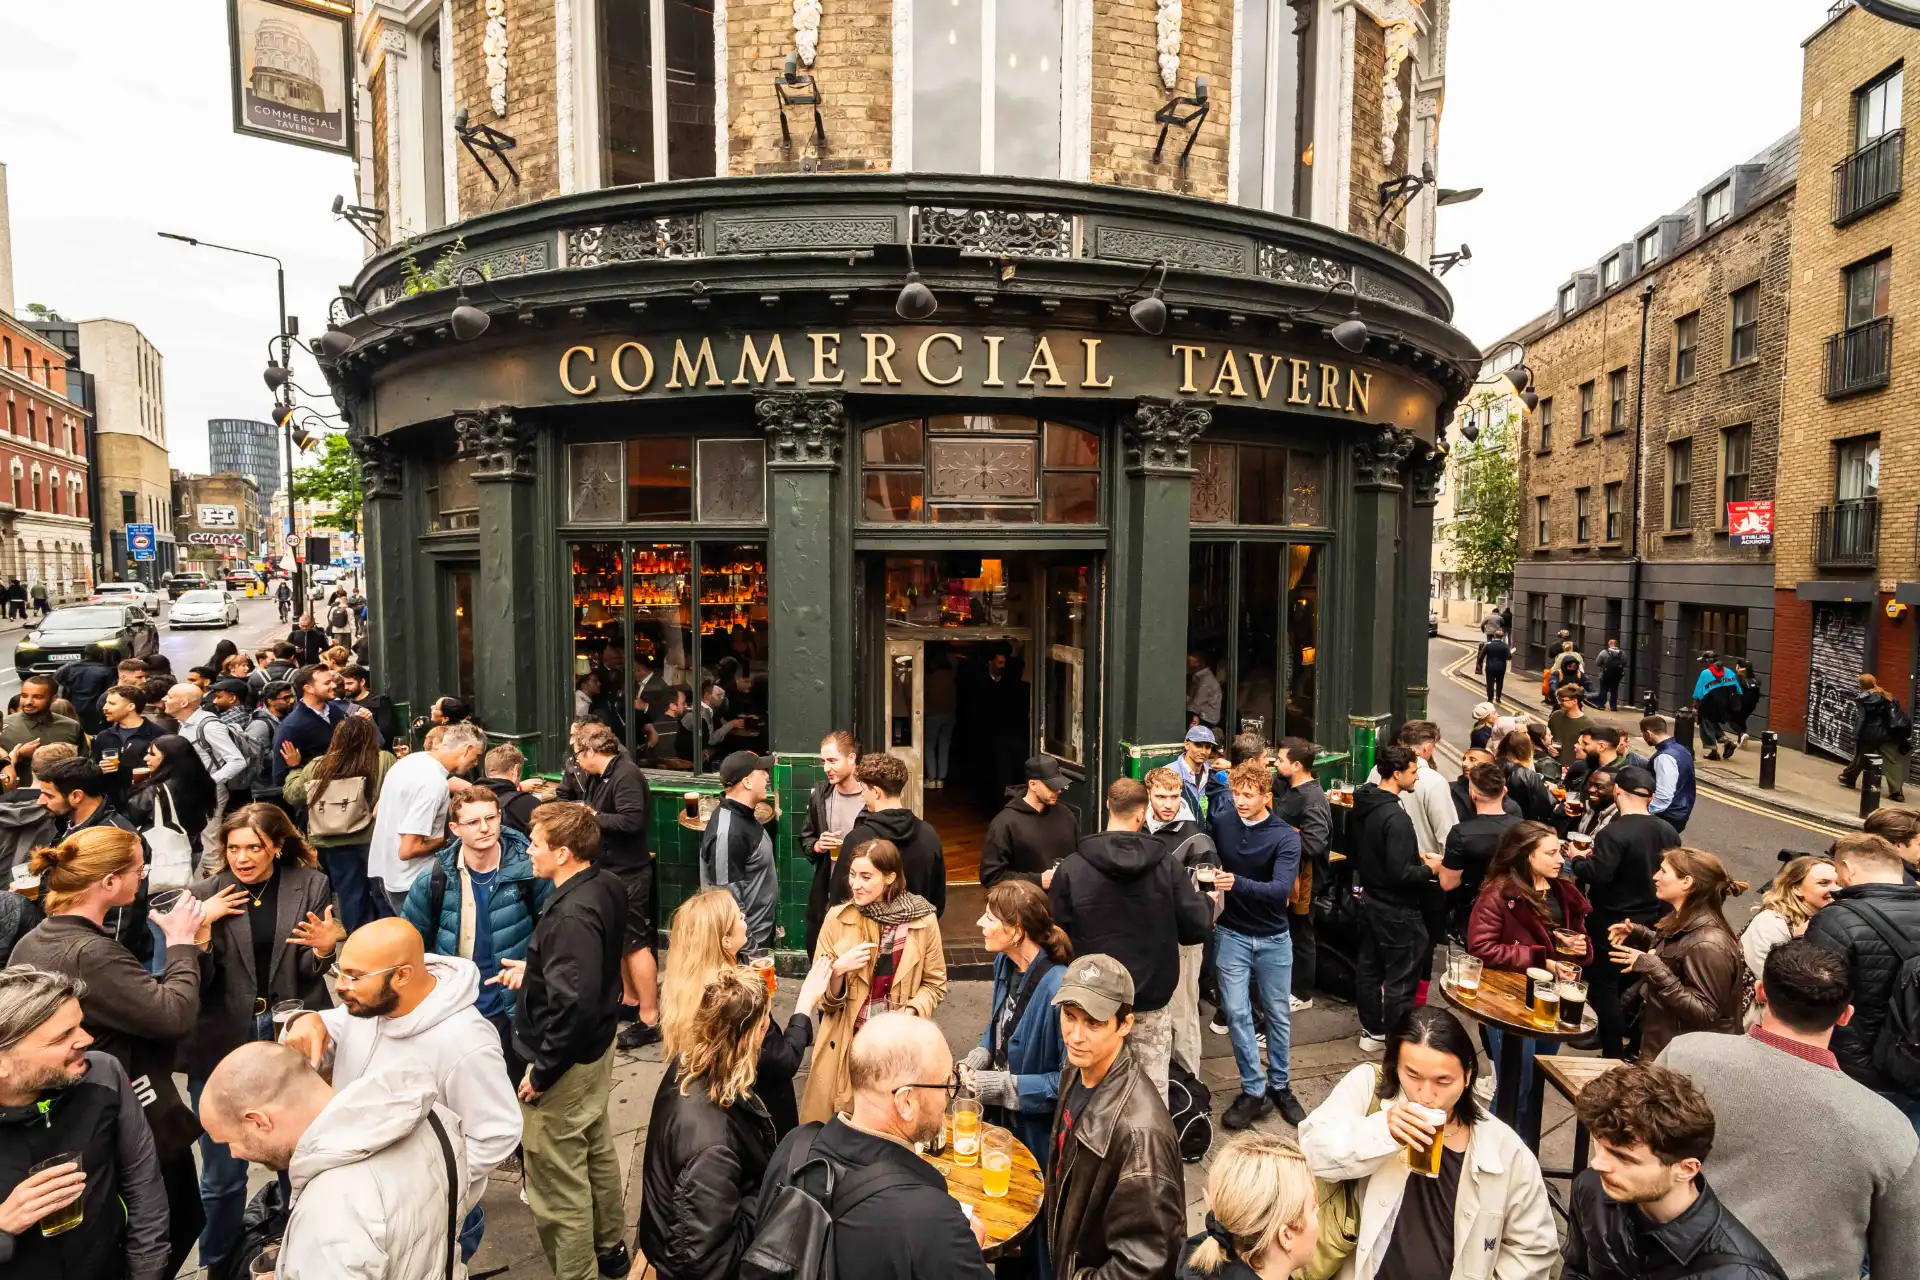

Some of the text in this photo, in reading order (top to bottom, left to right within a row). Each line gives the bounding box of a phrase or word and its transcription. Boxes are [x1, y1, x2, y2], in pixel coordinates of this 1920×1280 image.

[254, 105, 336, 130] COMMERCIAL
[275, 119, 315, 133] TAVERN
[558, 332, 1373, 415] COMMERCIAL TAVERN
